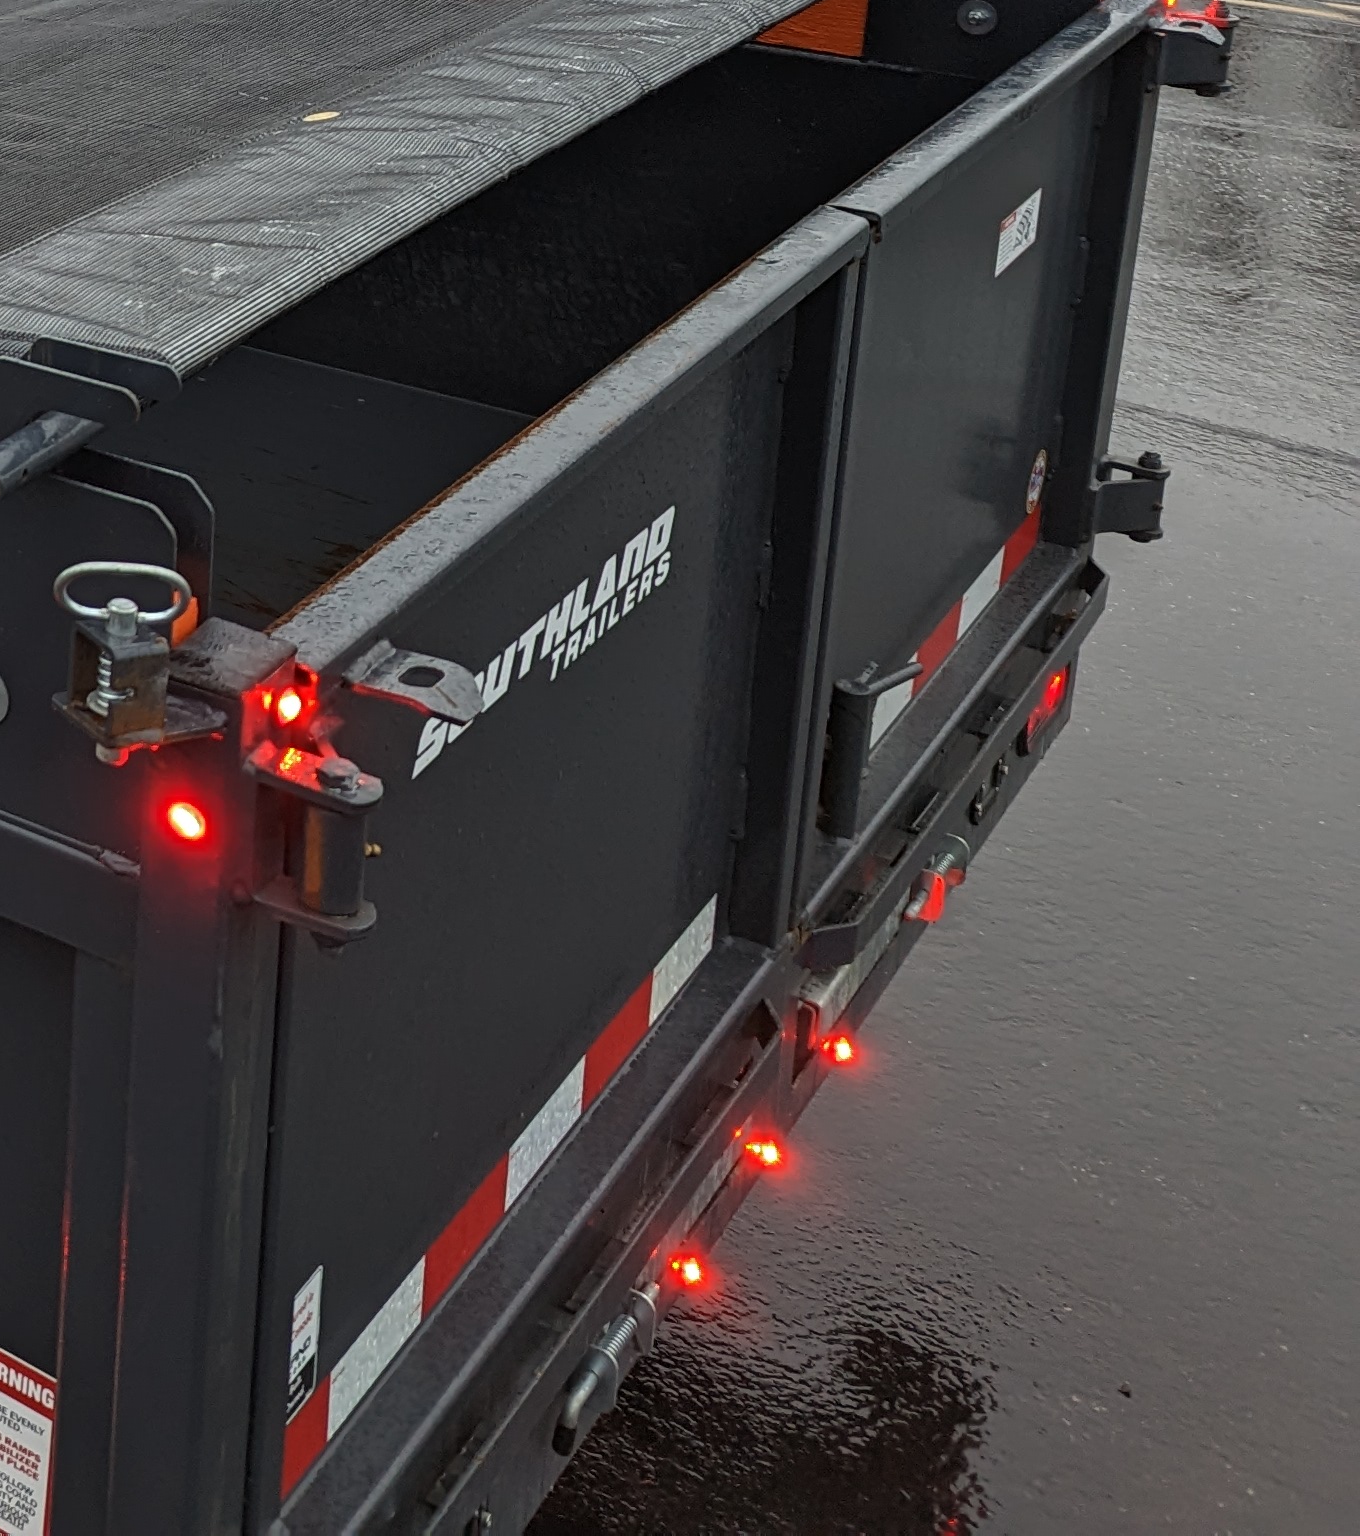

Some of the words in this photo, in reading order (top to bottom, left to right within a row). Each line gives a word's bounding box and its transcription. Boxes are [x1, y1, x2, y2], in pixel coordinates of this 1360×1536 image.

[550, 551, 671, 682] TRAILERS
[10, 1410, 45, 1436] EVENLY
[4, 1436, 41, 1463] RAMPS
[6, 1457, 39, 1482] PLACE
[5, 1484, 38, 1508] COULD
[15, 1500, 36, 1517] AND
